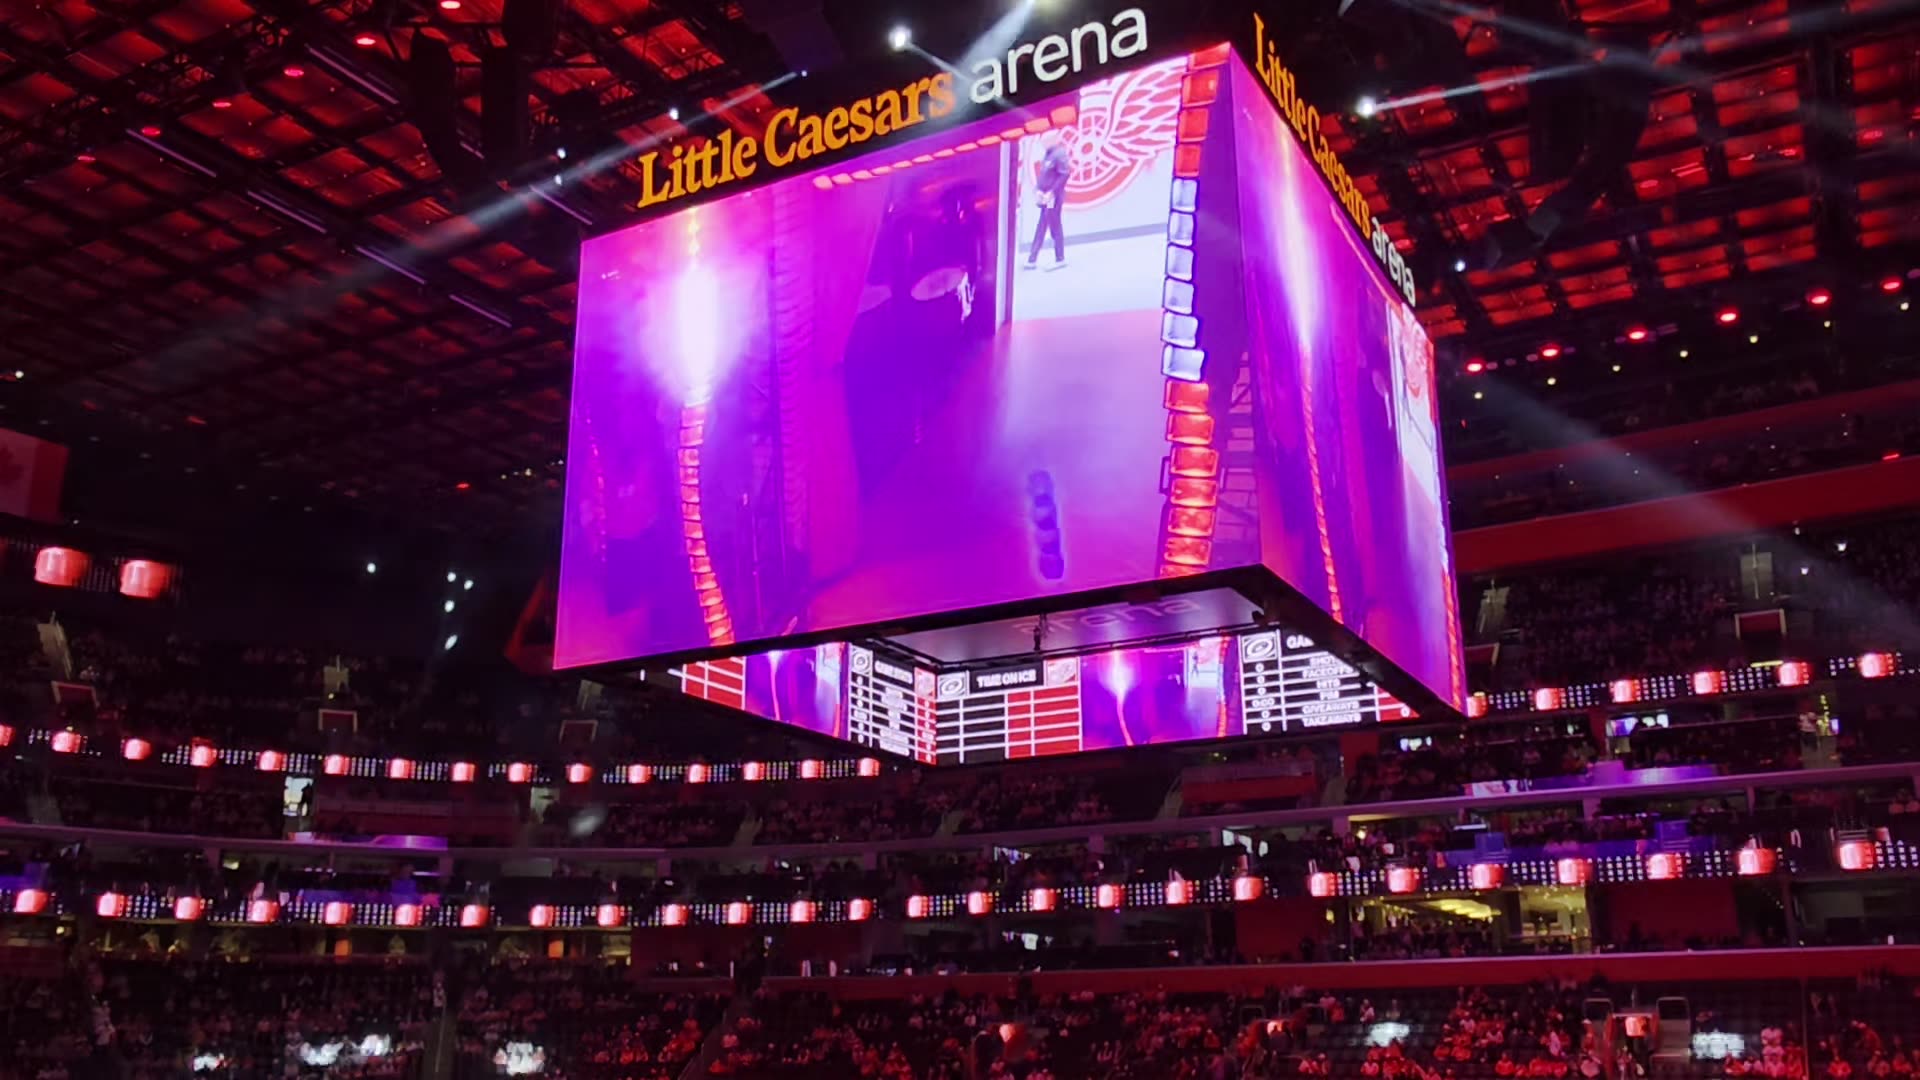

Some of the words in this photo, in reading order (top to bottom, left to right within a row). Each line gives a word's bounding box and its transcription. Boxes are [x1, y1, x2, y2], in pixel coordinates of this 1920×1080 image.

[637, 126, 757, 208] Little
[764, 72, 956, 169] Caesars
[968, 7, 1147, 104] arena
[1254, 12, 1306, 141] Little
[1307, 105, 1371, 240] Caesars
[1371, 217, 1415, 307] arena
